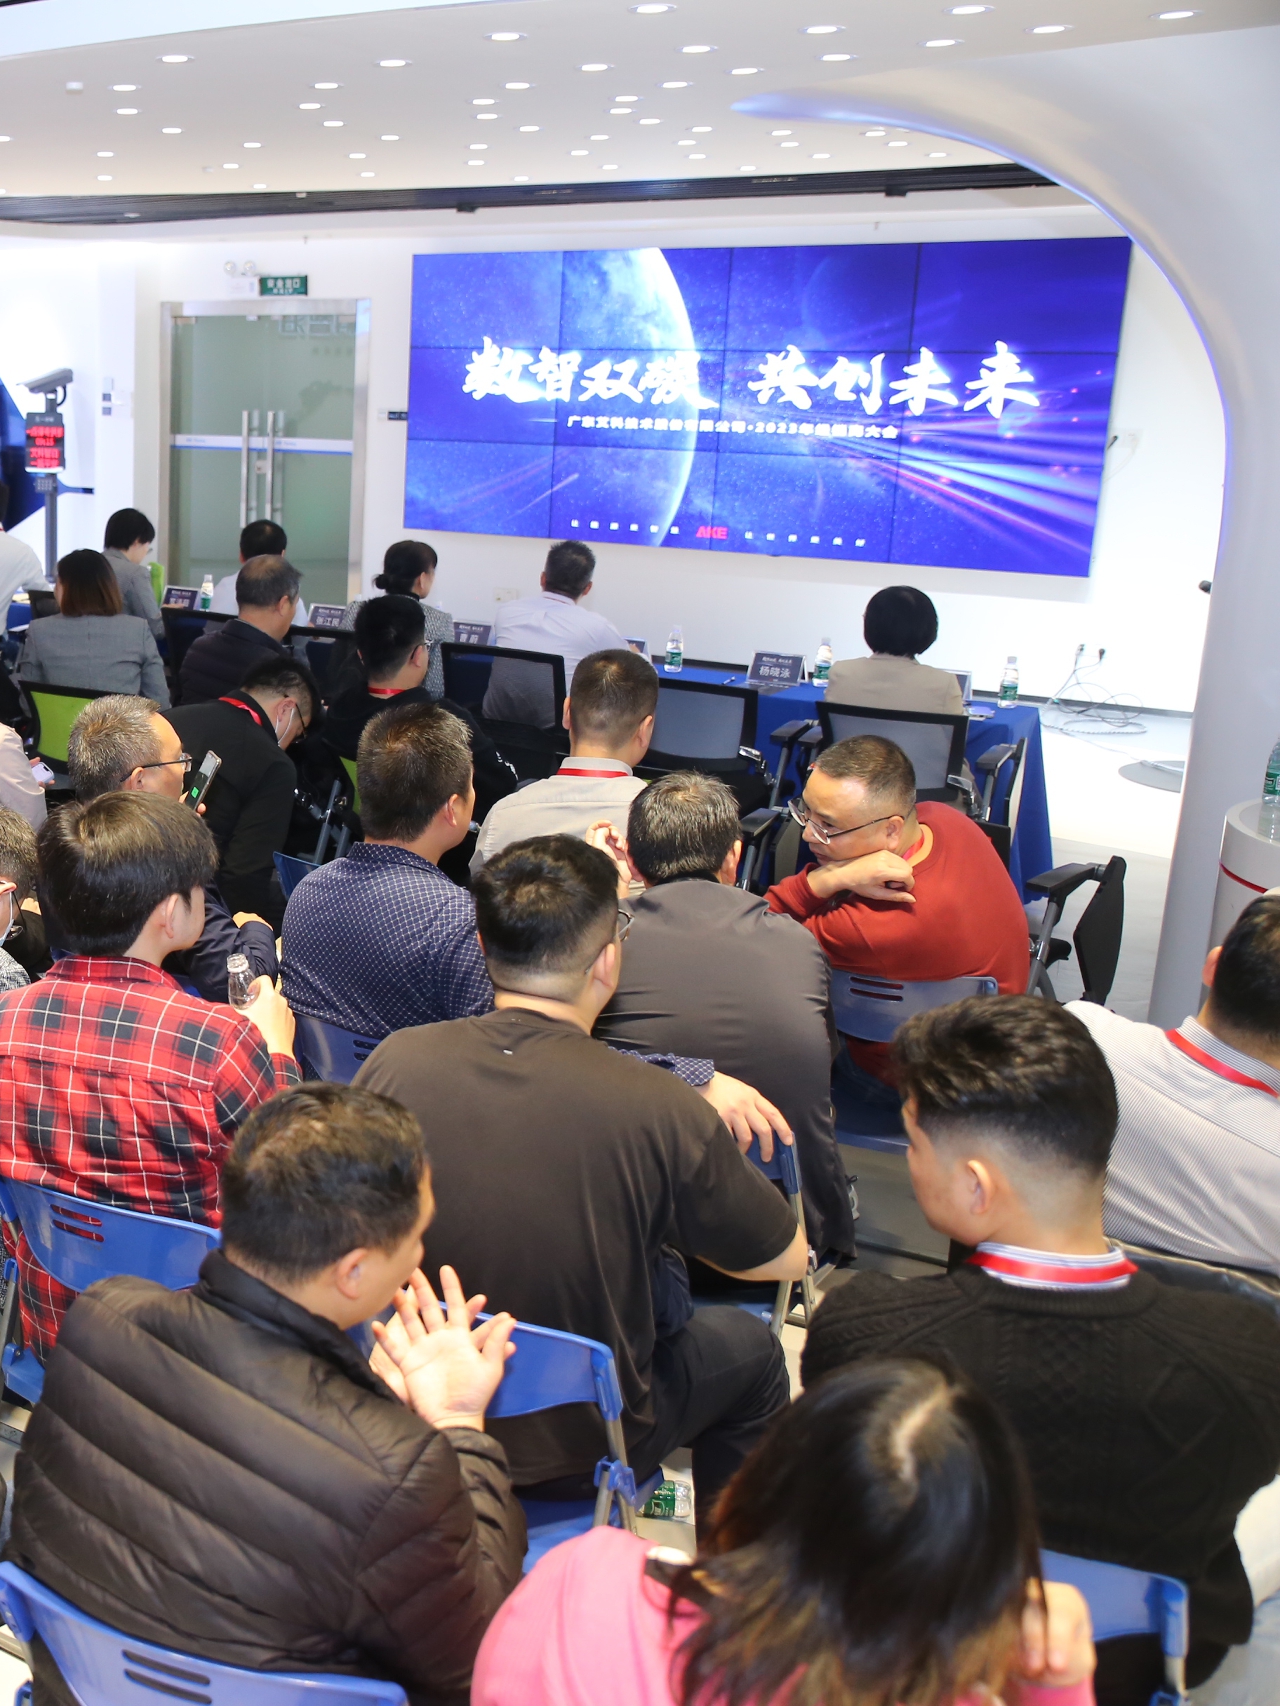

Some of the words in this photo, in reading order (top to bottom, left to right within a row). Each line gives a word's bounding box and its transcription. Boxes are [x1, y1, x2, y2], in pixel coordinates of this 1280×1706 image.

[747, 340, 1040, 419] 共创未来
[695, 525, 728, 540] AKE
